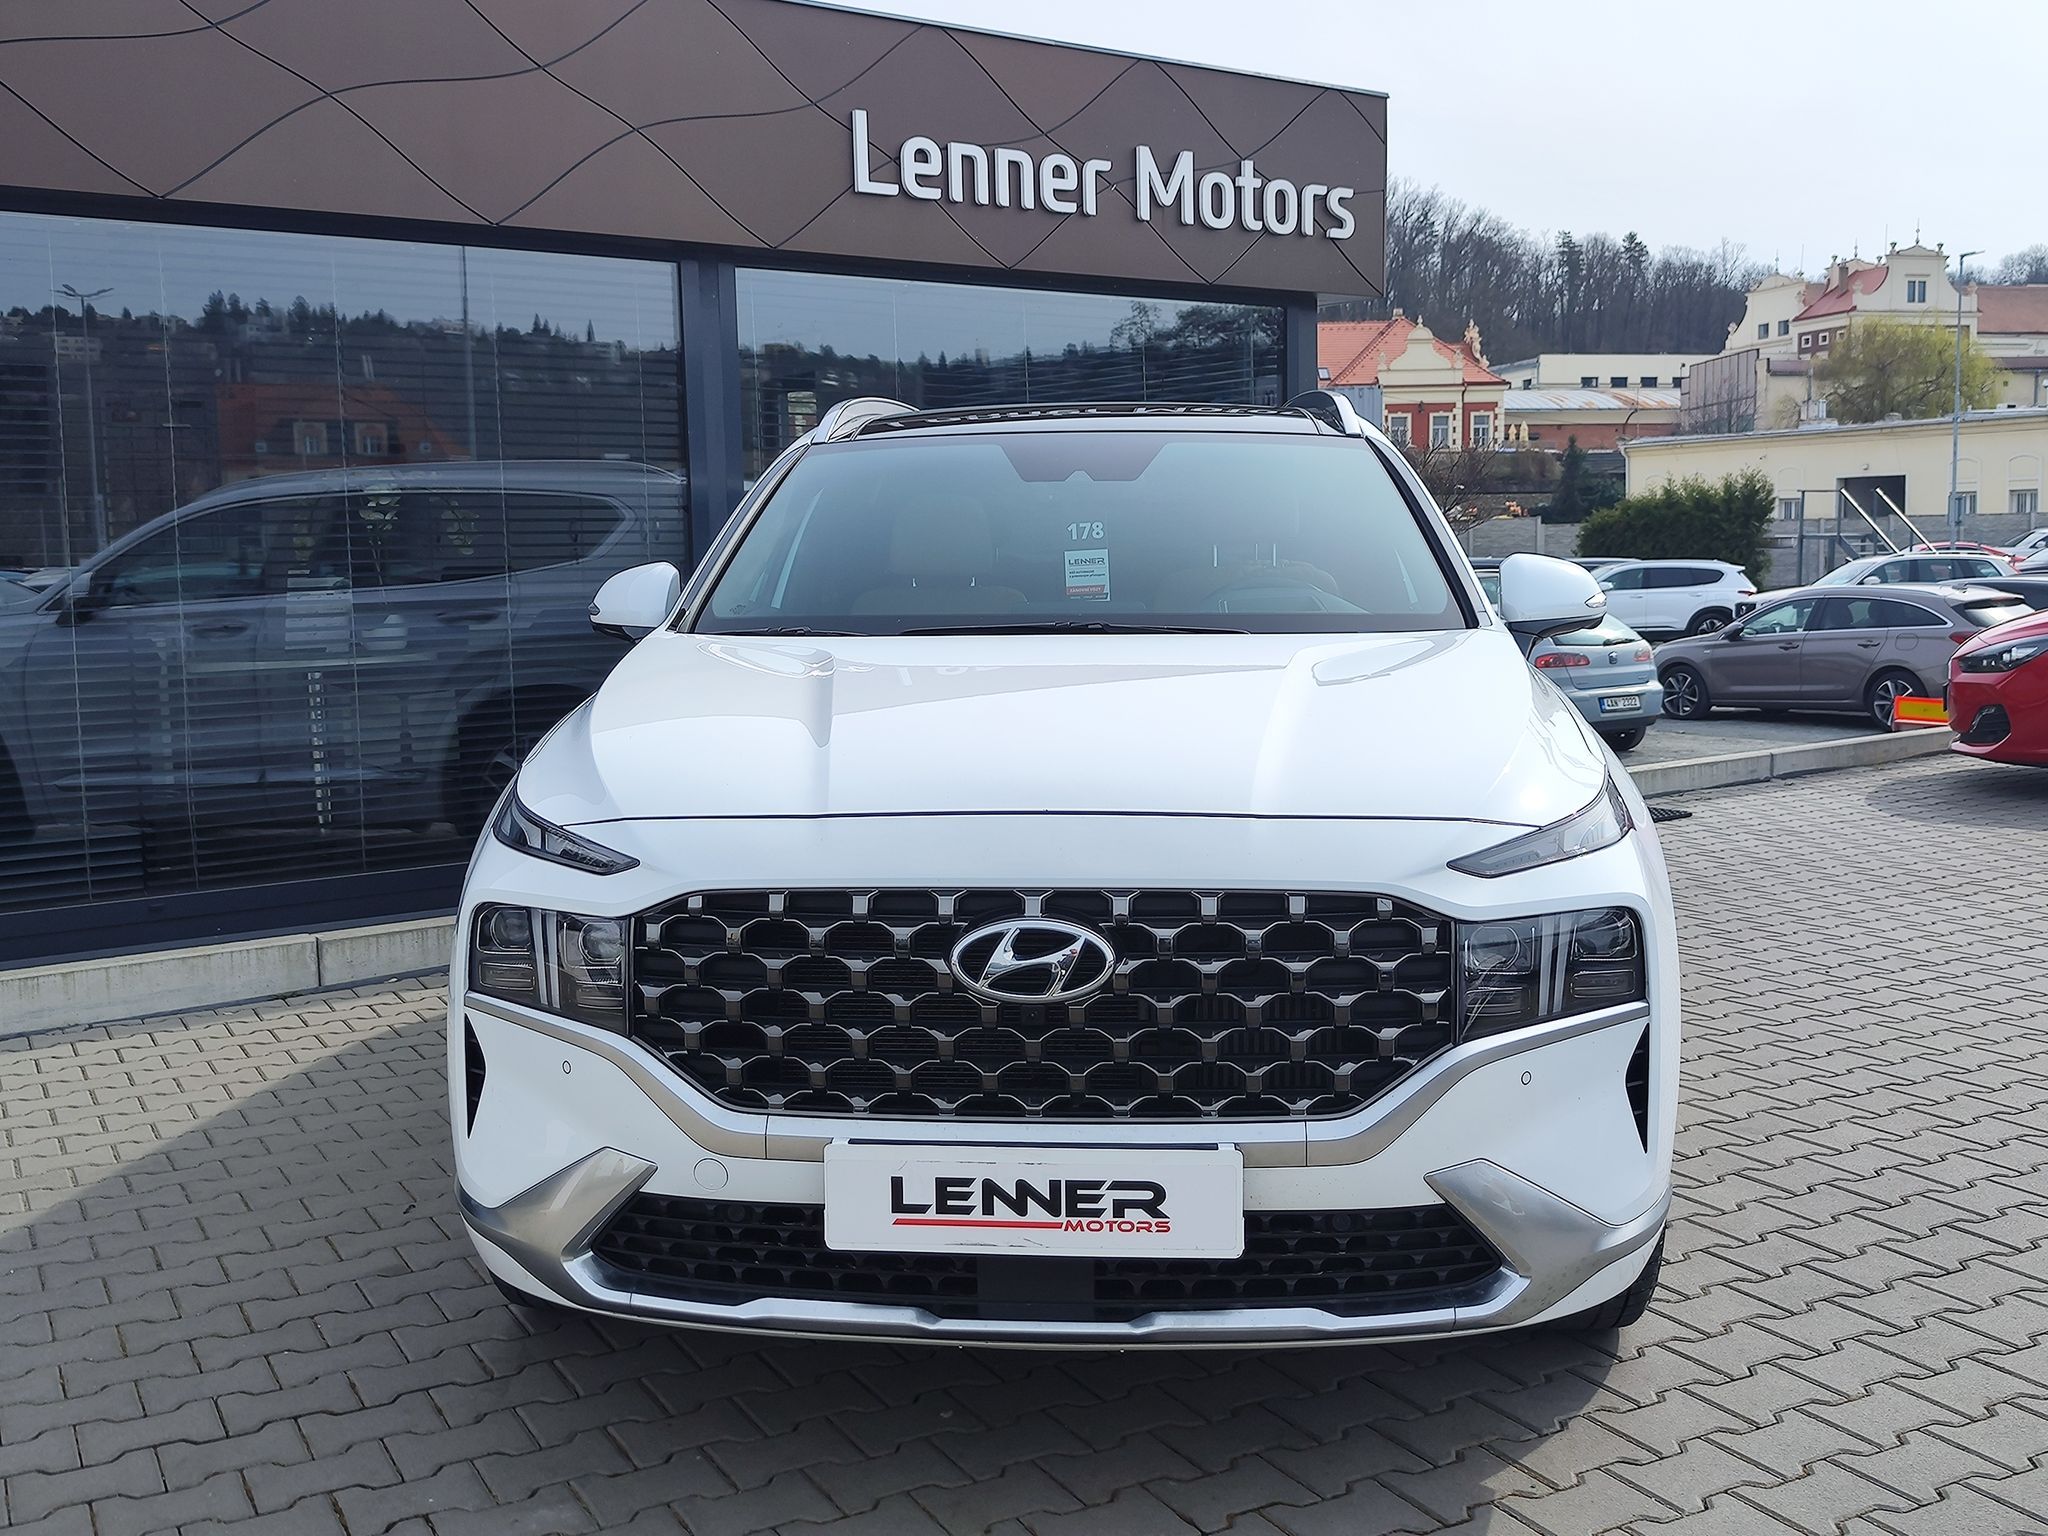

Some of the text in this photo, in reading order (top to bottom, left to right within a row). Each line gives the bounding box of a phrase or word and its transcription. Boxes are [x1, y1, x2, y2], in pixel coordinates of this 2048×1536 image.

[851, 109, 1356, 240] Lenner Motors
[1066, 521, 1104, 540] 178
[1068, 557, 1106, 566] LENNER
[890, 1175, 1170, 1219] LENNER
[1063, 1219, 1172, 1233] MOTORS
